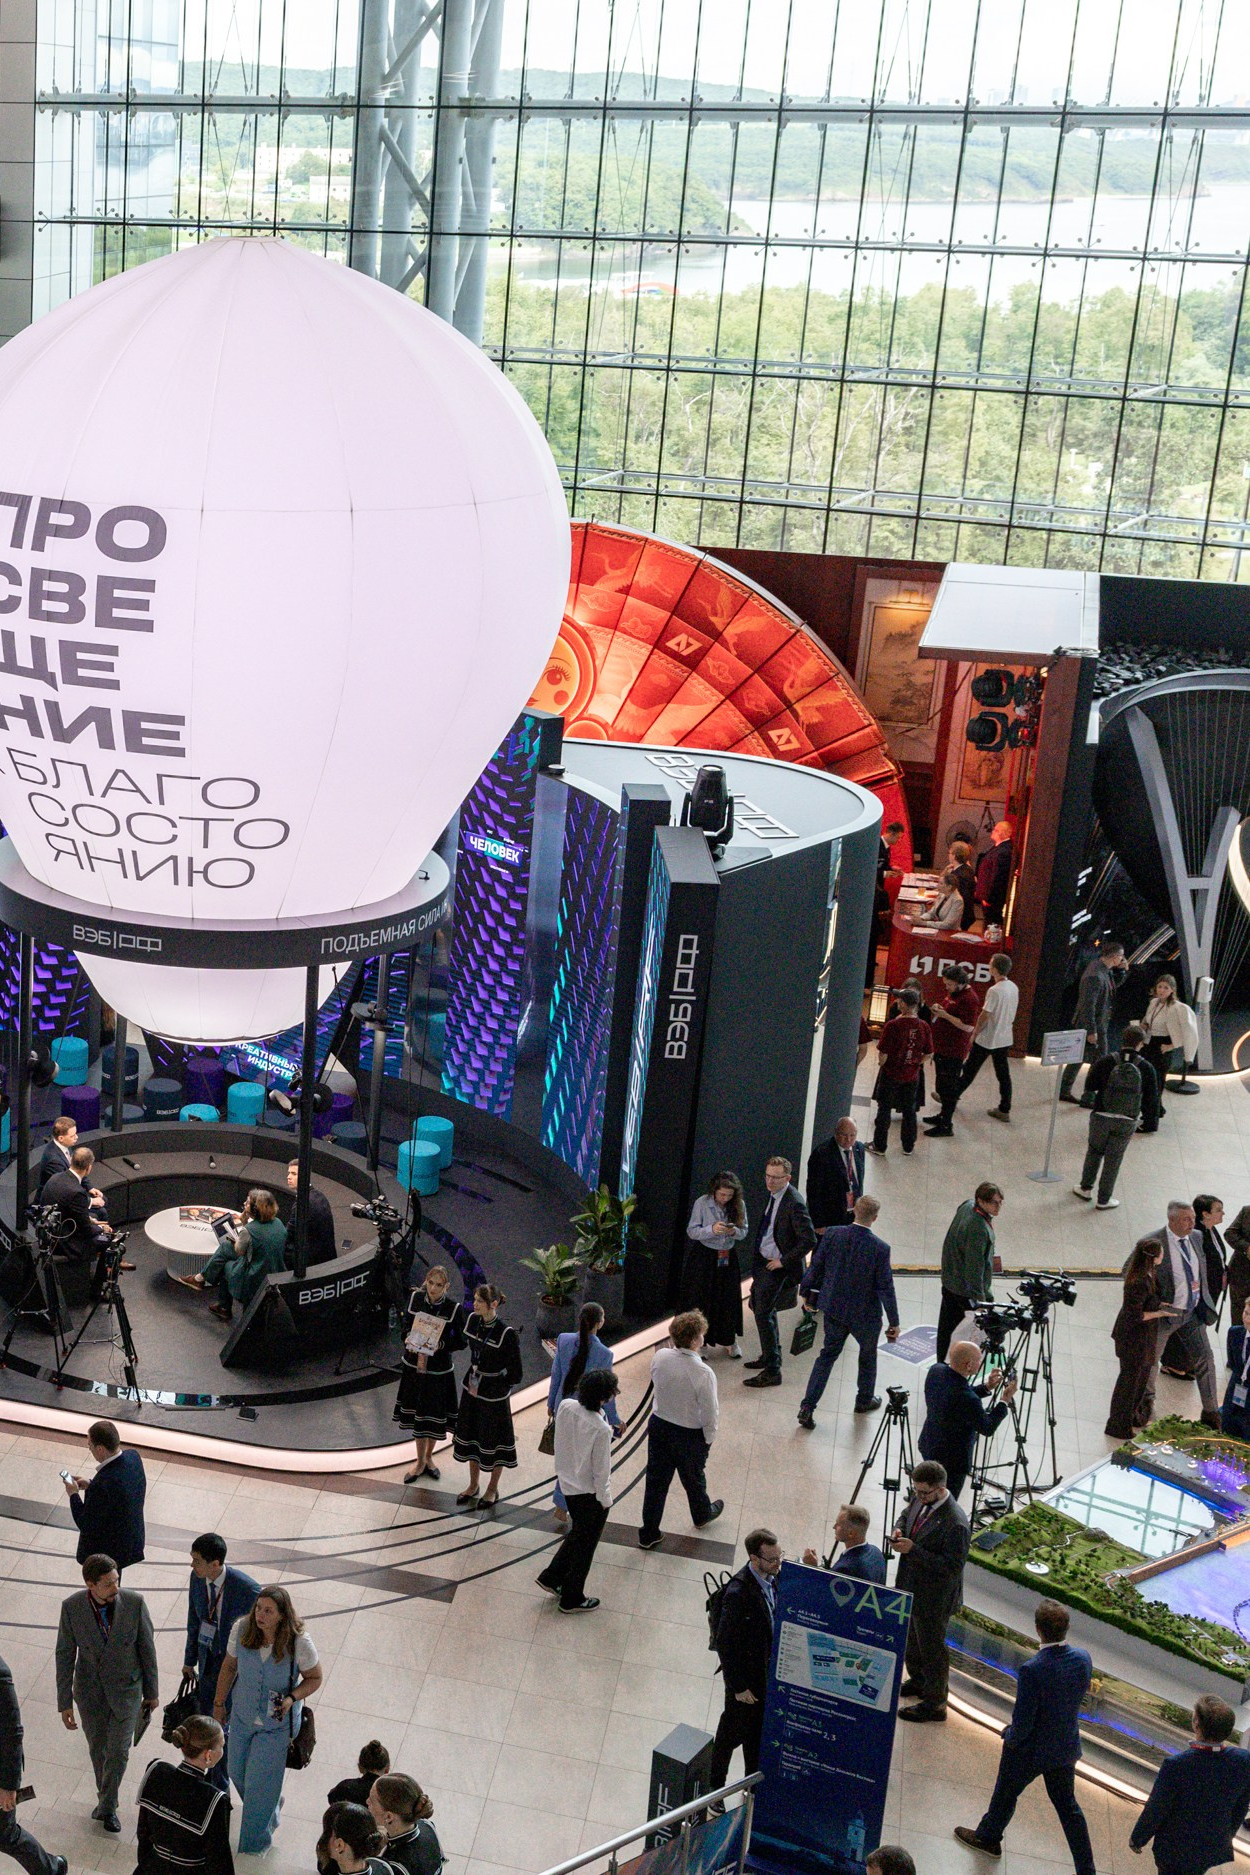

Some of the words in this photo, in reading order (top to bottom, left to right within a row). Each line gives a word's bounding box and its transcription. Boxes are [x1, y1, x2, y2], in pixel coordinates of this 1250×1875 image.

[6, 747, 261, 810] БЛАГО
[28, 791, 290, 850] СОСТО
[45, 832, 256, 889] ЯНИЮ
[470, 836, 520, 863] ЧЕЛОВЕК
[321, 919, 416, 954] ПОДЪЕМНАЯ
[418, 905, 441, 931] СИЛА
[235, 1042, 299, 1072] КРЕАТИВНЫ
[854, 1585, 911, 1625] A4
